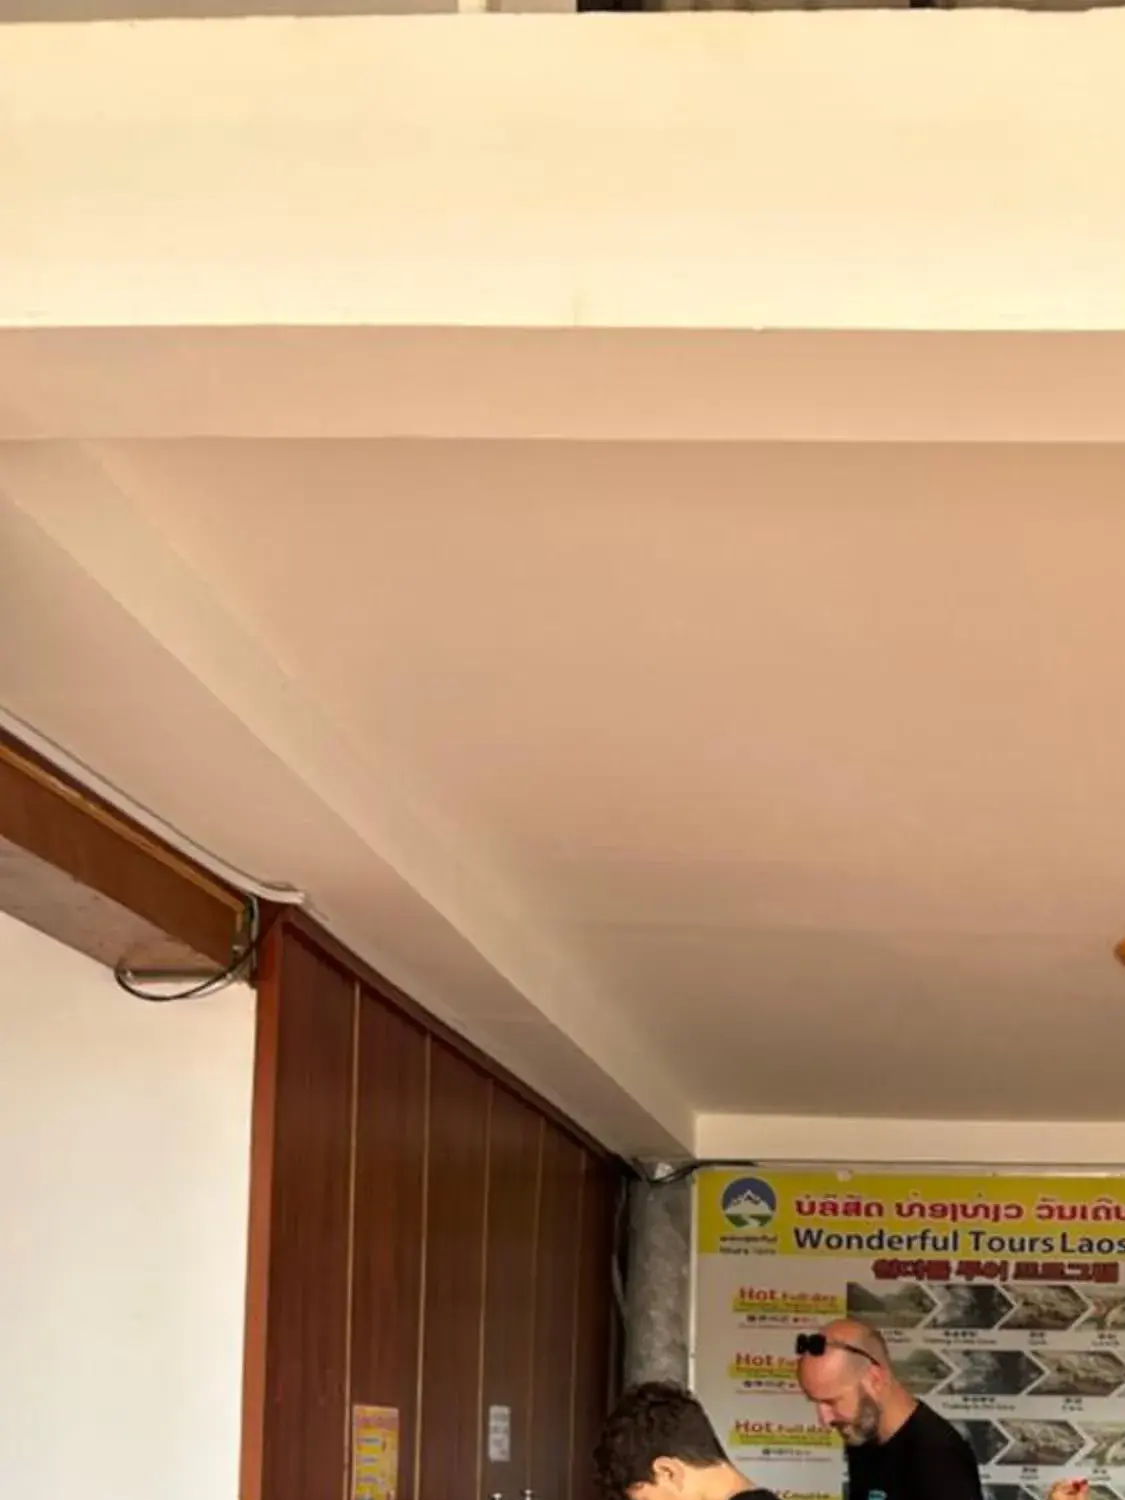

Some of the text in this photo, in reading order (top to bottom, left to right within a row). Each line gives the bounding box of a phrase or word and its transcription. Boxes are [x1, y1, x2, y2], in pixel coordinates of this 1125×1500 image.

[793, 1227, 958, 1252] Wonderful
[968, 1230, 1054, 1253] Tours
[738, 1286, 776, 1301] Hot
[735, 1352, 772, 1366] Hot
[734, 1419, 772, 1433] Hot
